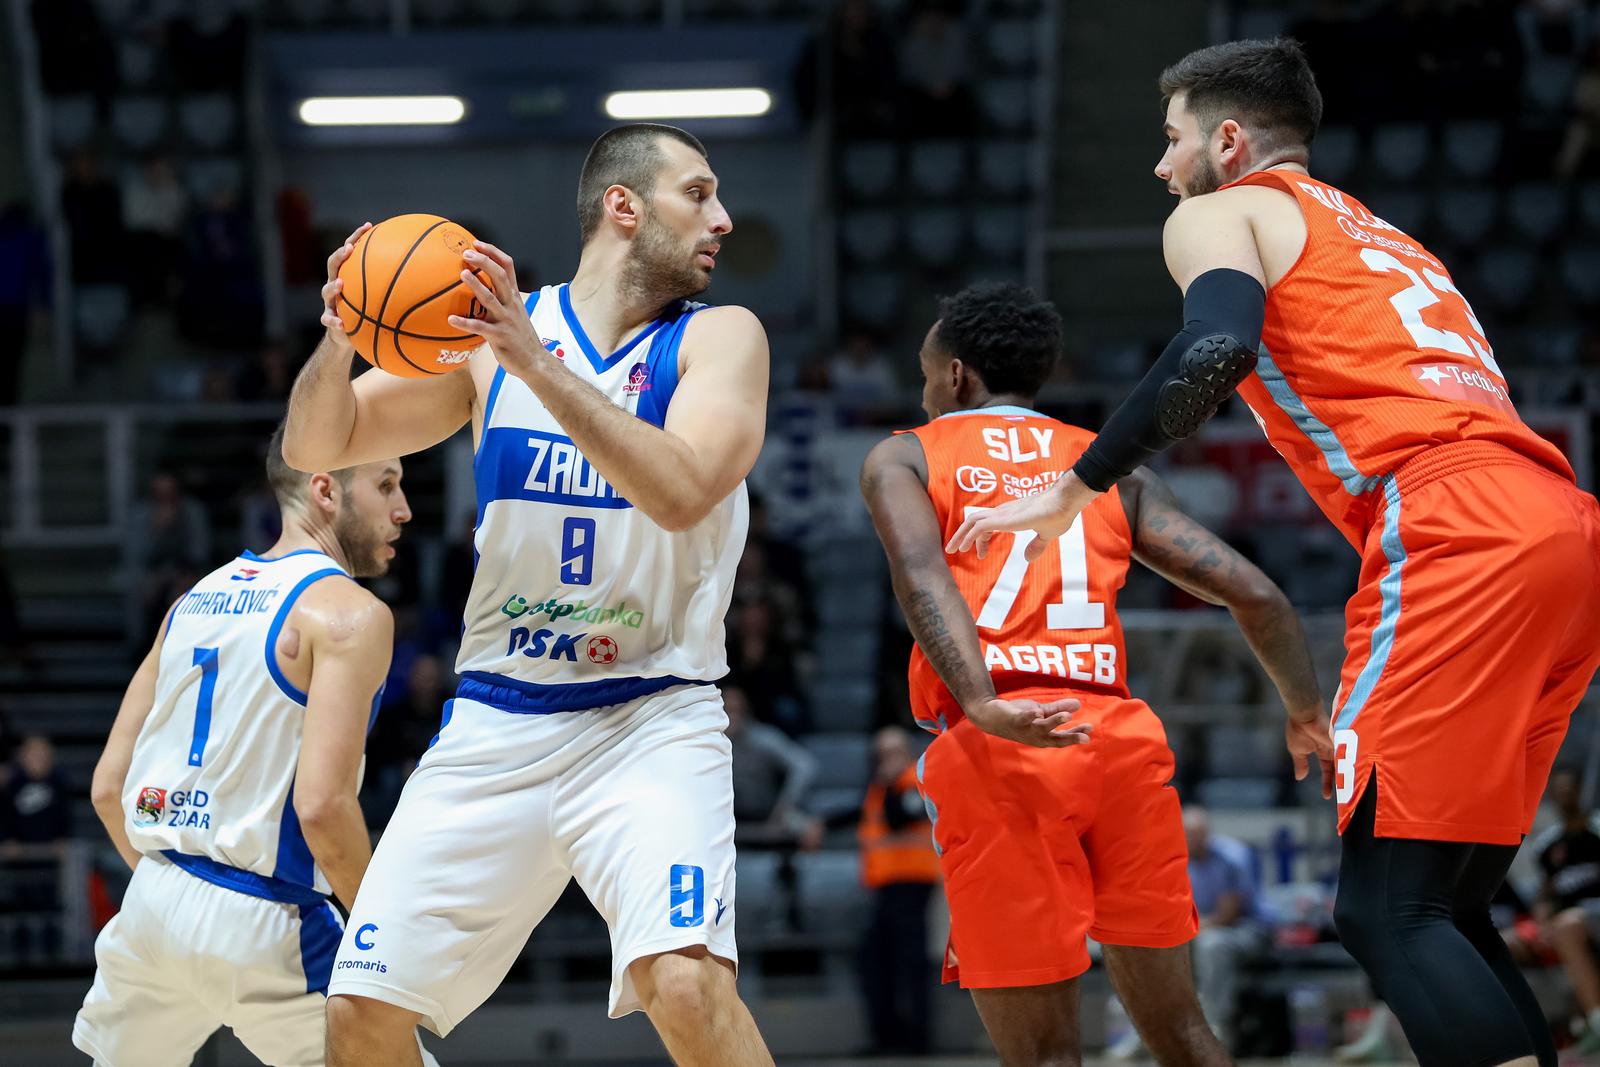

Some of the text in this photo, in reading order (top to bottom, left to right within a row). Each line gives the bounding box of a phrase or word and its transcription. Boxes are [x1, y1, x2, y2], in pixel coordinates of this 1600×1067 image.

[1359, 247, 1505, 380] 23
[523, 437, 626, 499] ZAD
[981, 426, 1054, 464] SLY
[560, 516, 596, 586] 9
[963, 506, 1105, 631] 71
[985, 643, 1118, 685] AGREB
[188, 647, 219, 767] 1
[669, 863, 705, 928] 9
[337, 960, 388, 974] cromaris
